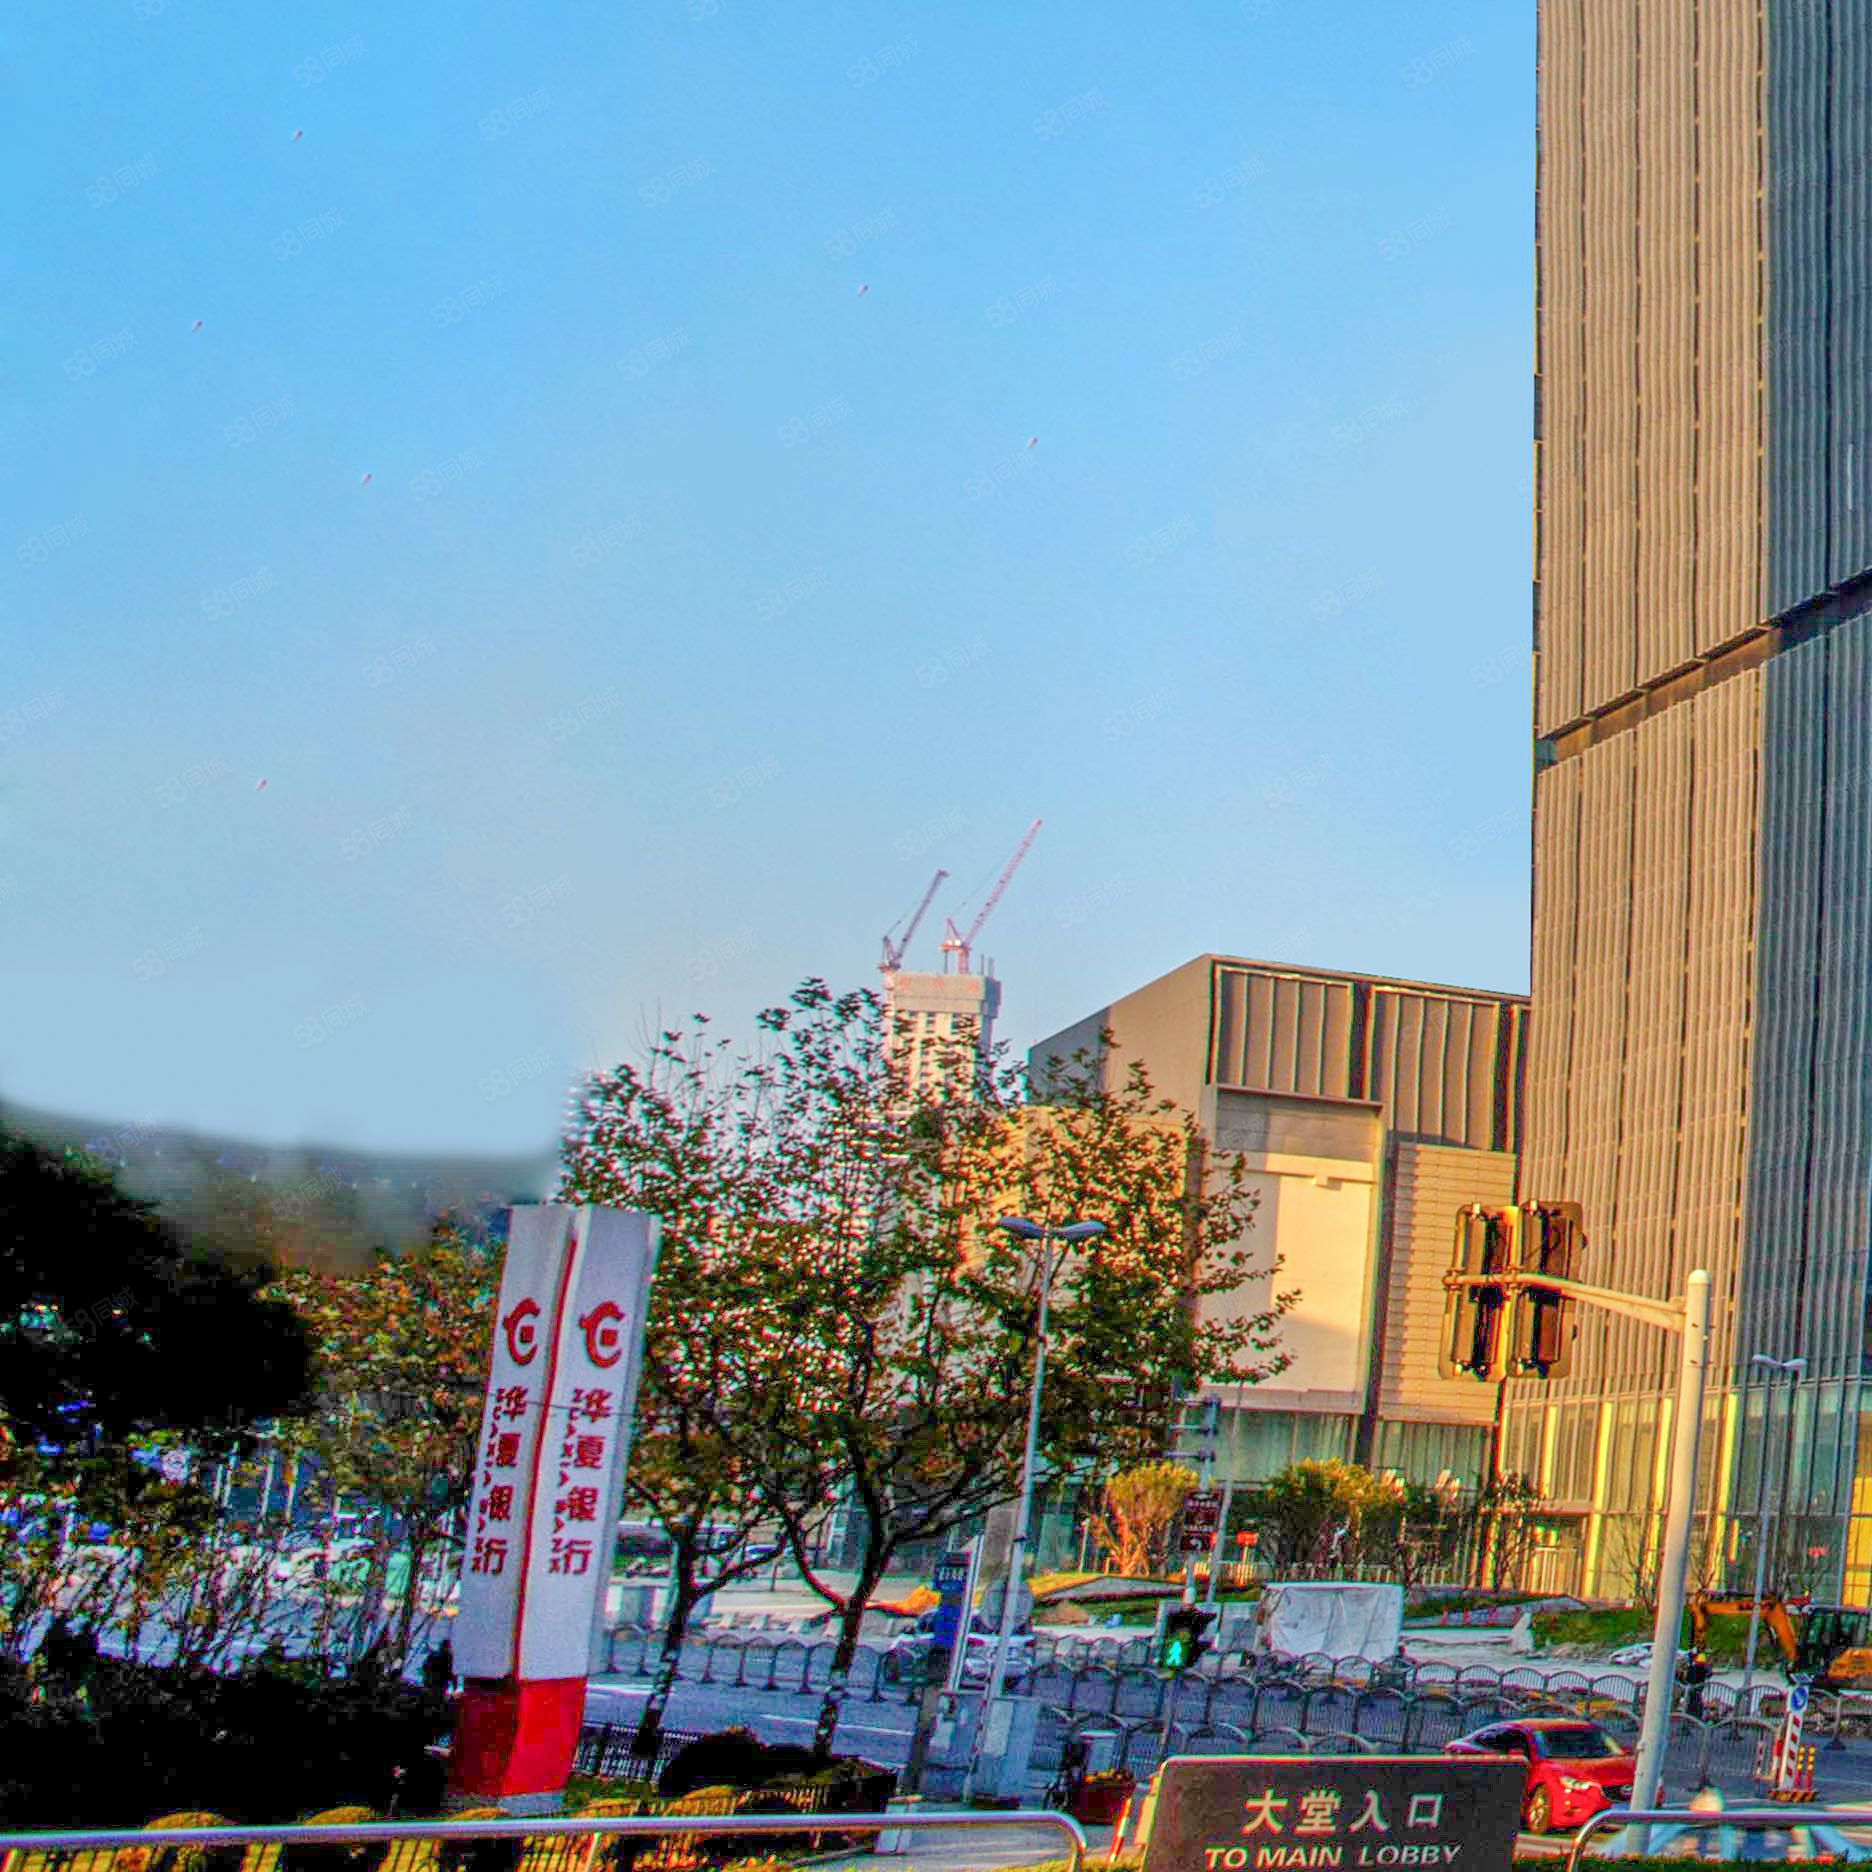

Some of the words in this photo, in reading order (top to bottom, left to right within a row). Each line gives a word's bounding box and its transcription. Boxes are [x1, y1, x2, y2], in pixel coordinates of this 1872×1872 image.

[484, 1385, 529, 1575] 华夏银行
[561, 1387, 613, 1575] 华夏银行
[1204, 1846, 1248, 1870] TO
[1256, 1845, 1344, 1870] MAIN
[1358, 1844, 1462, 1868] LOBBY
[1240, 1787, 1444, 1834] 大堂入口
